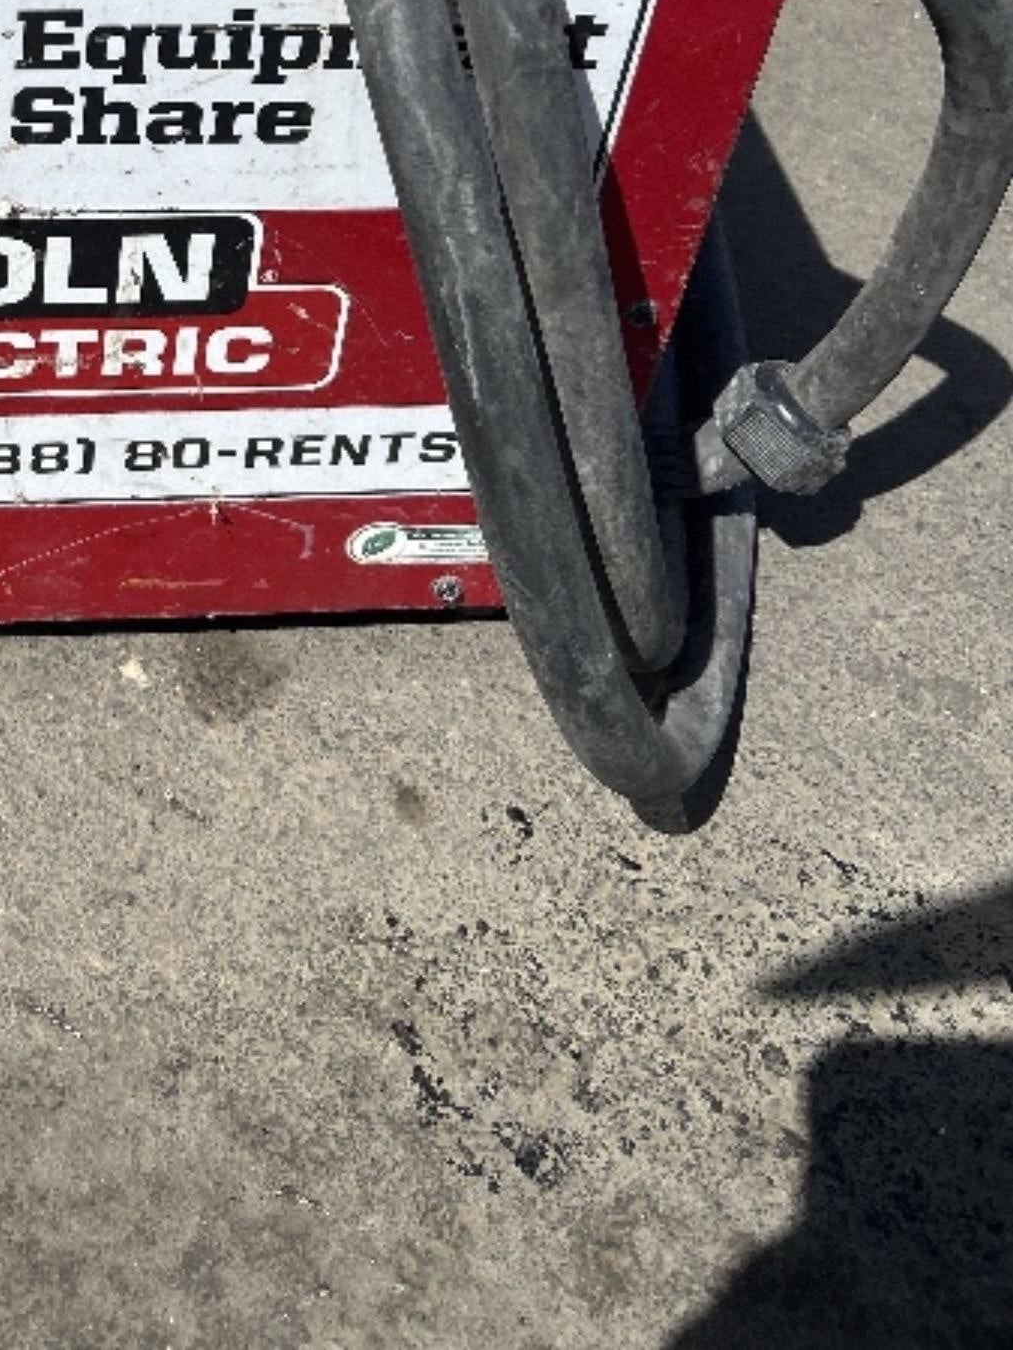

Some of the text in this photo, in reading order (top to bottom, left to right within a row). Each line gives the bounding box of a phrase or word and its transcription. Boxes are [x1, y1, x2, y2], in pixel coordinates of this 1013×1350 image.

[15, 8, 608, 83] Equipt
[10, 87, 315, 145] Share
[124, 430, 458, 473] 80-RENTS
